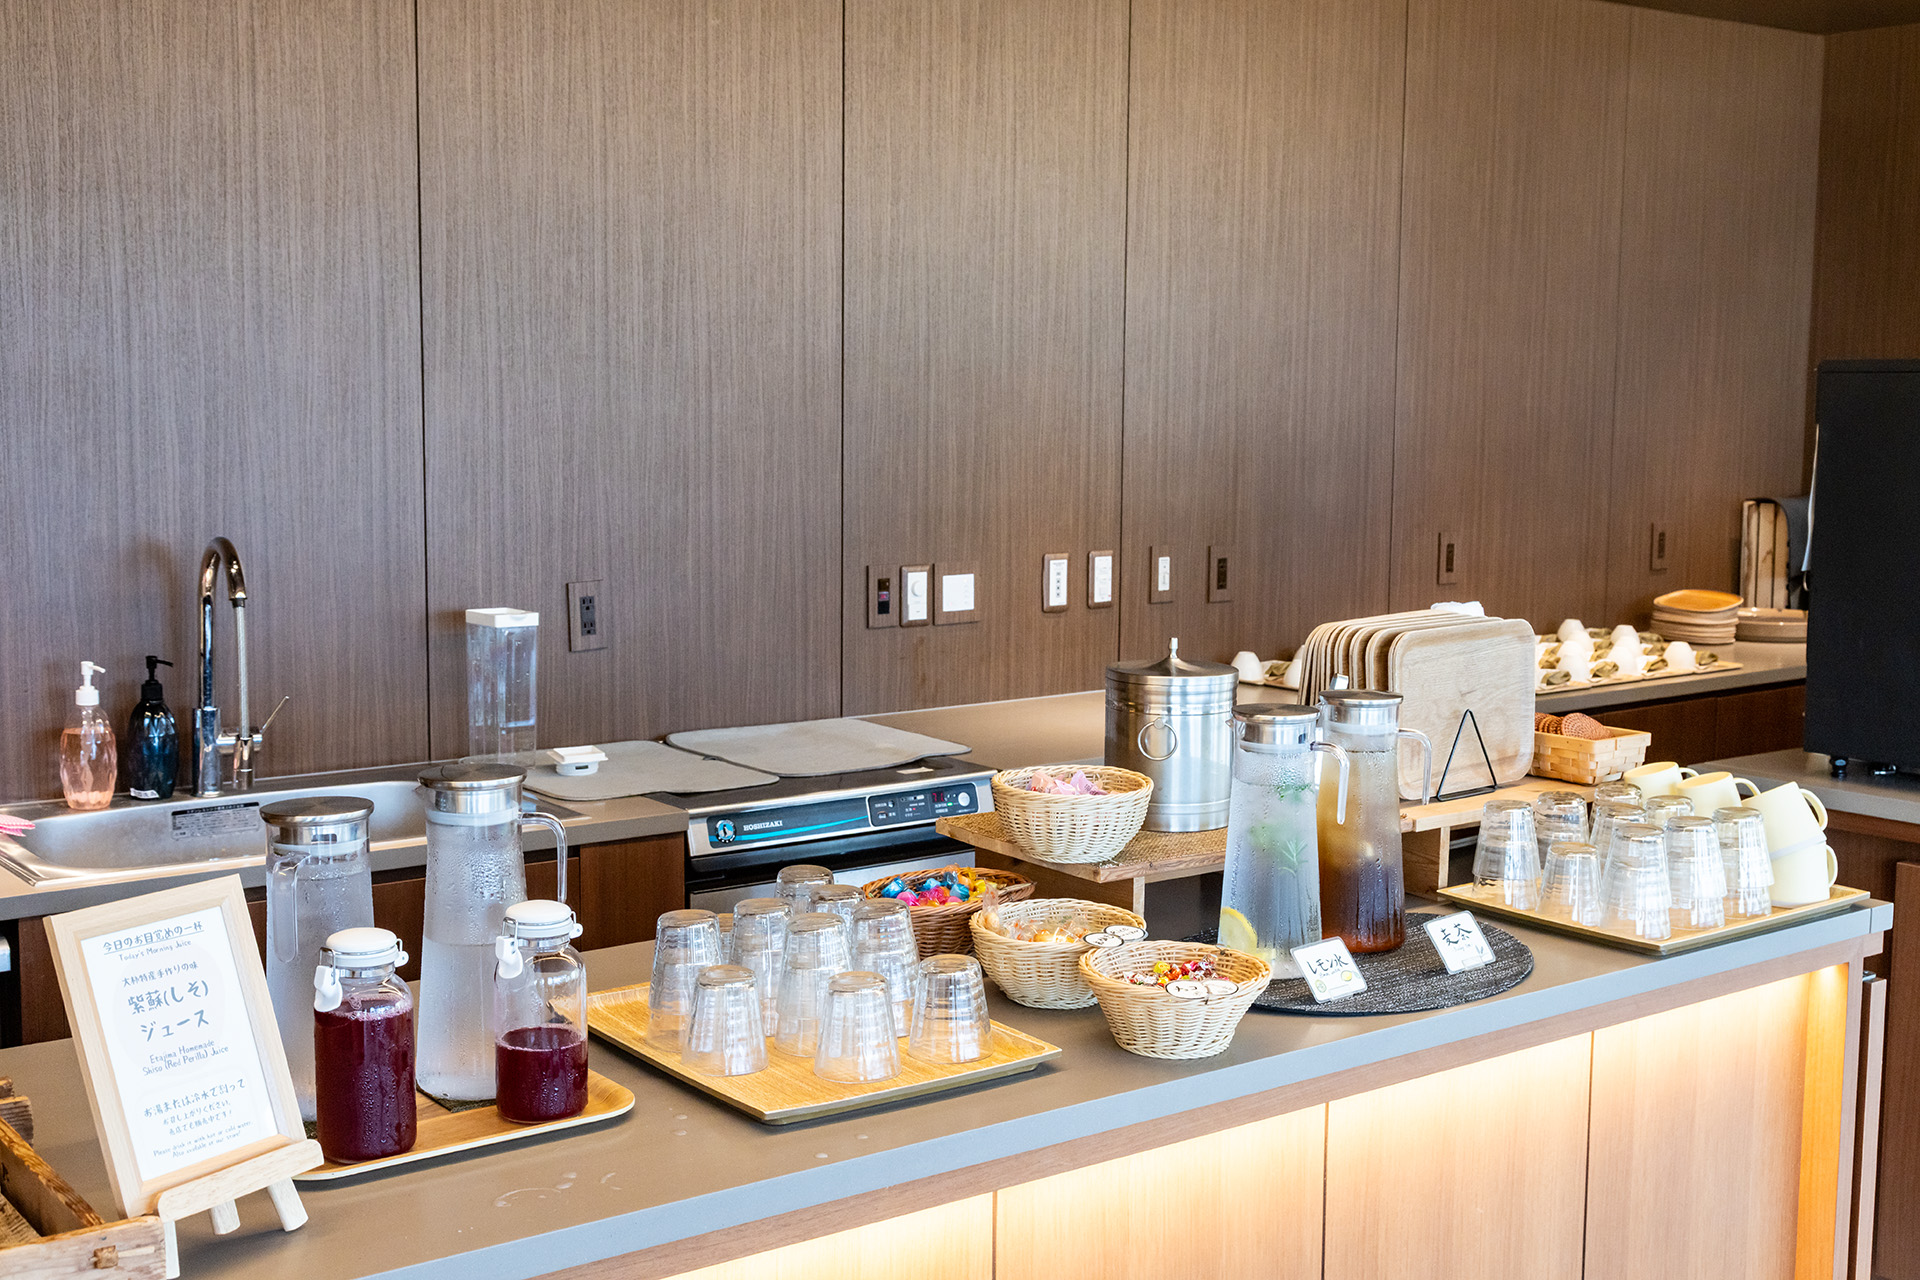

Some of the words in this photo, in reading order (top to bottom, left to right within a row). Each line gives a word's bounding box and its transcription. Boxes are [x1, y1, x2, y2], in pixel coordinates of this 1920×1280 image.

[743, 820, 783, 831] HOSHIZAKI
[103, 921, 203, 952] 今日のお目覚めの一杯
[1440, 923, 1473, 946] 麦茶
[119, 950, 145, 961] Today's
[146, 946, 173, 955] Morning
[175, 940, 191, 948] Juice
[1306, 953, 1349, 974] レモン水
[128, 980, 209, 1015] 紫蘇(しそ)
[140, 1009, 210, 1042] ジュース
[142, 1066, 163, 1076] Shiso
[164, 1058, 181, 1070] (Red
[183, 1049, 208, 1064] Perilla)
[211, 1046, 229, 1056] Juice
[149, 1051, 177, 1064] Etajima
[178, 1039, 215, 1055] Homemade
